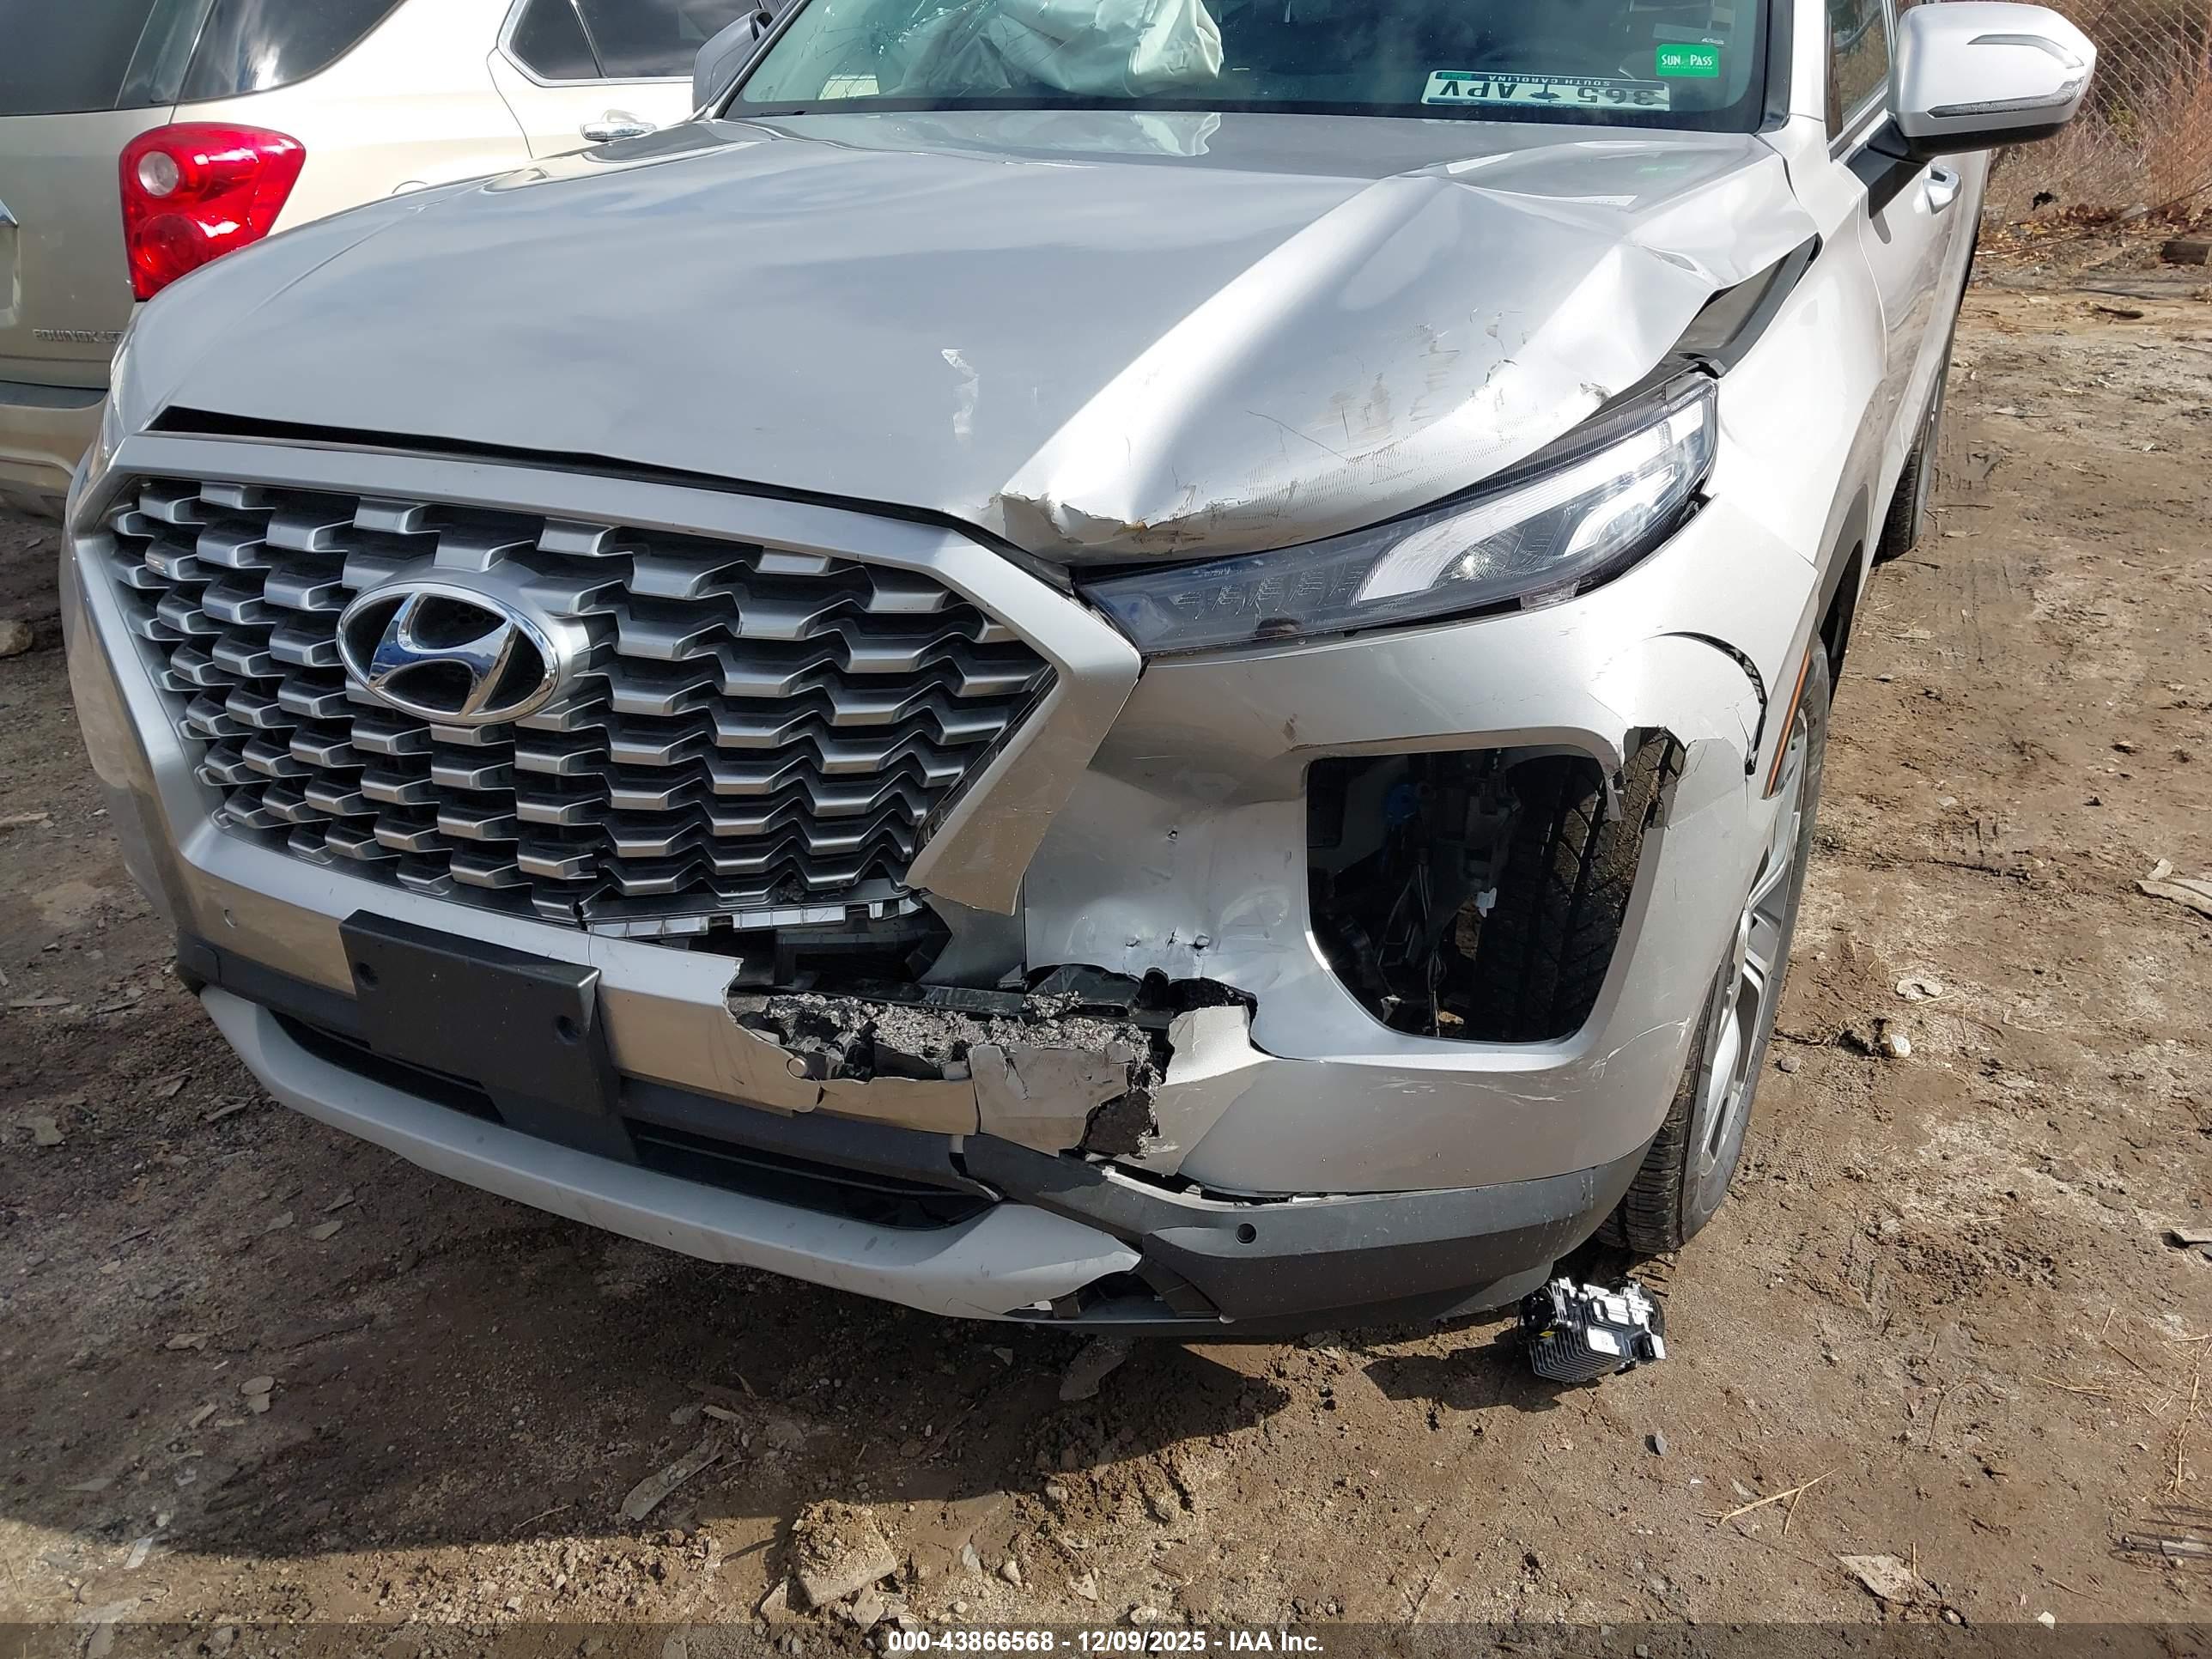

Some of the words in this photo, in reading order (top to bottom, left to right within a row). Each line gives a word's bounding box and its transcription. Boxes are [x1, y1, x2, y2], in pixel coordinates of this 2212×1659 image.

[1487, 75, 1559, 84] CAROLINA
[1438, 80, 1518, 99] APV
[1577, 86, 1656, 106] 365
[33, 329, 99, 343] EQUINOX
